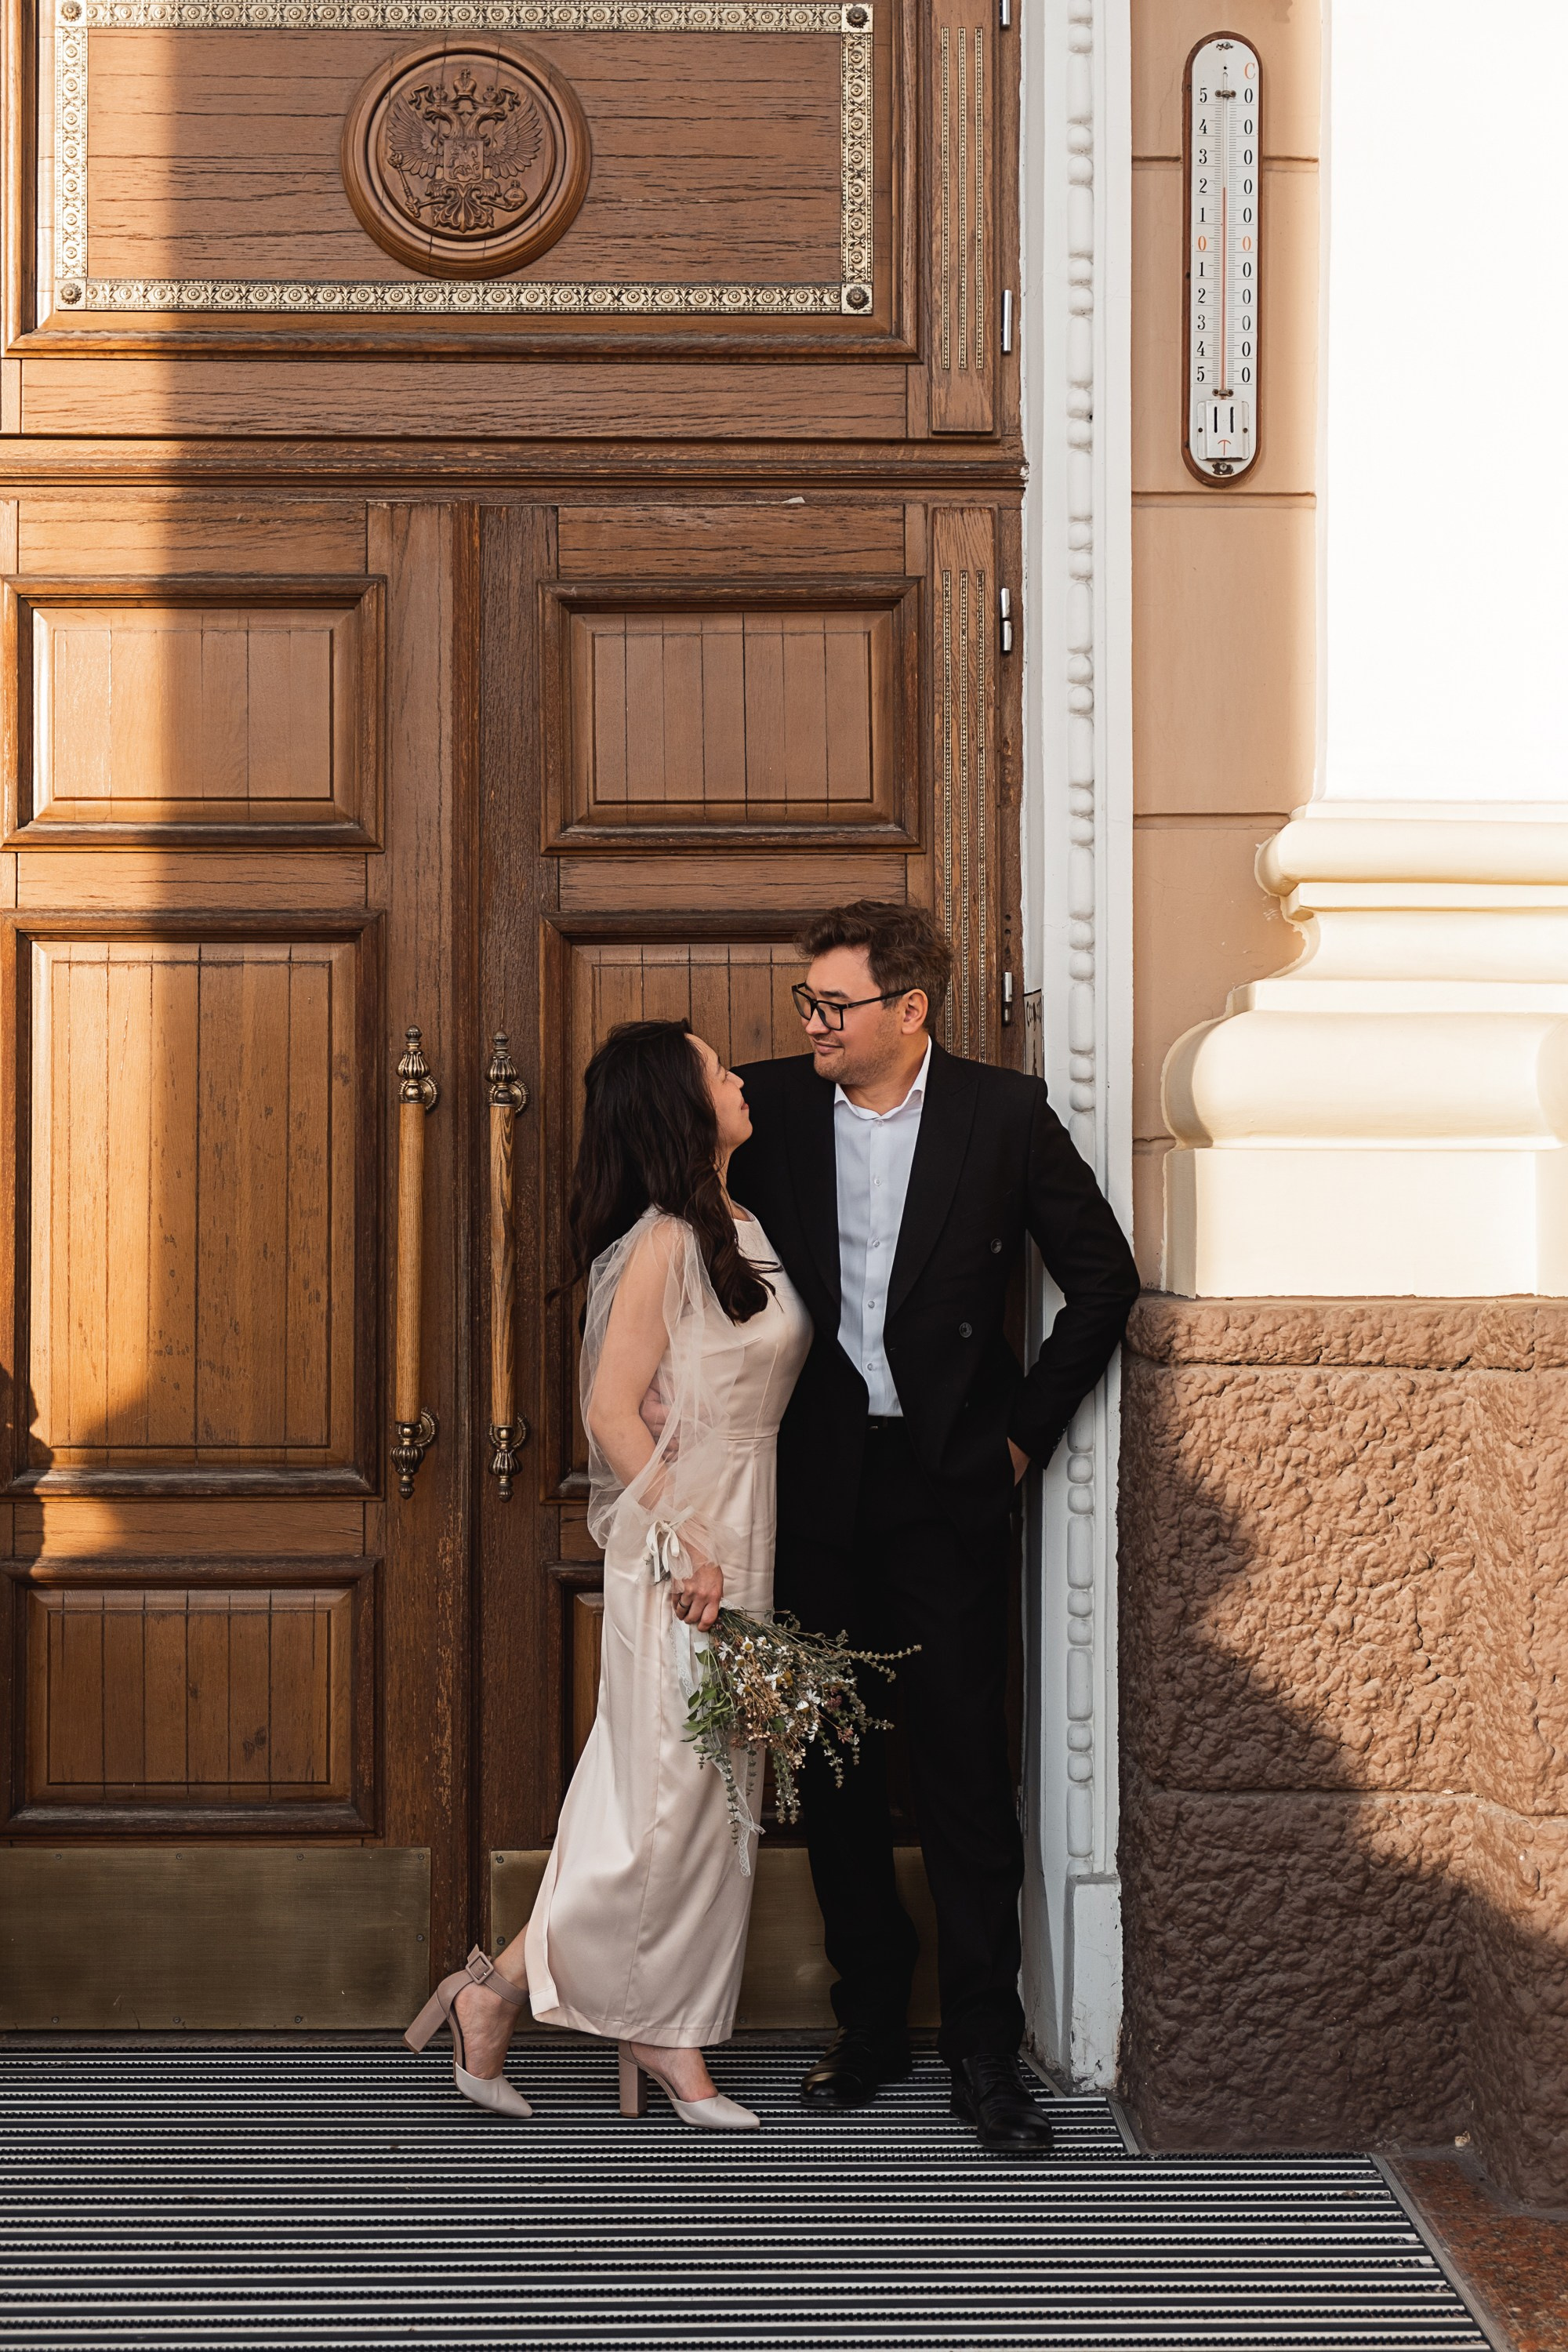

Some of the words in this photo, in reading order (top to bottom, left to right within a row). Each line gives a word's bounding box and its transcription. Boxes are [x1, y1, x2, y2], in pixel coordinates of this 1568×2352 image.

[1244, 62, 1256, 80] C
[1200, 87, 1207, 103] 5
[1244, 88, 1254, 103] 0
[1199, 118, 1207, 135] 4
[1243, 118, 1253, 135] 0
[1199, 148, 1207, 164] 3
[1243, 149, 1253, 165] 0
[1199, 177, 1207, 194] 2
[1243, 179, 1253, 194] 0
[1200, 207, 1207, 223] 1
[1243, 207, 1252, 223] 0
[1198, 235, 1207, 251] 0
[1242, 236, 1251, 252] 0
[1199, 261, 1205, 277] 1
[1243, 261, 1252, 278] 0
[1197, 288, 1206, 303] 2
[1242, 289, 1251, 304] 0
[1197, 314, 1206, 330] 3
[1242, 315, 1251, 331] 0
[1196, 340, 1205, 357] 4
[1241, 341, 1251, 357] 0
[1196, 366, 1205, 382] 5
[1241, 367, 1250, 383] 0
